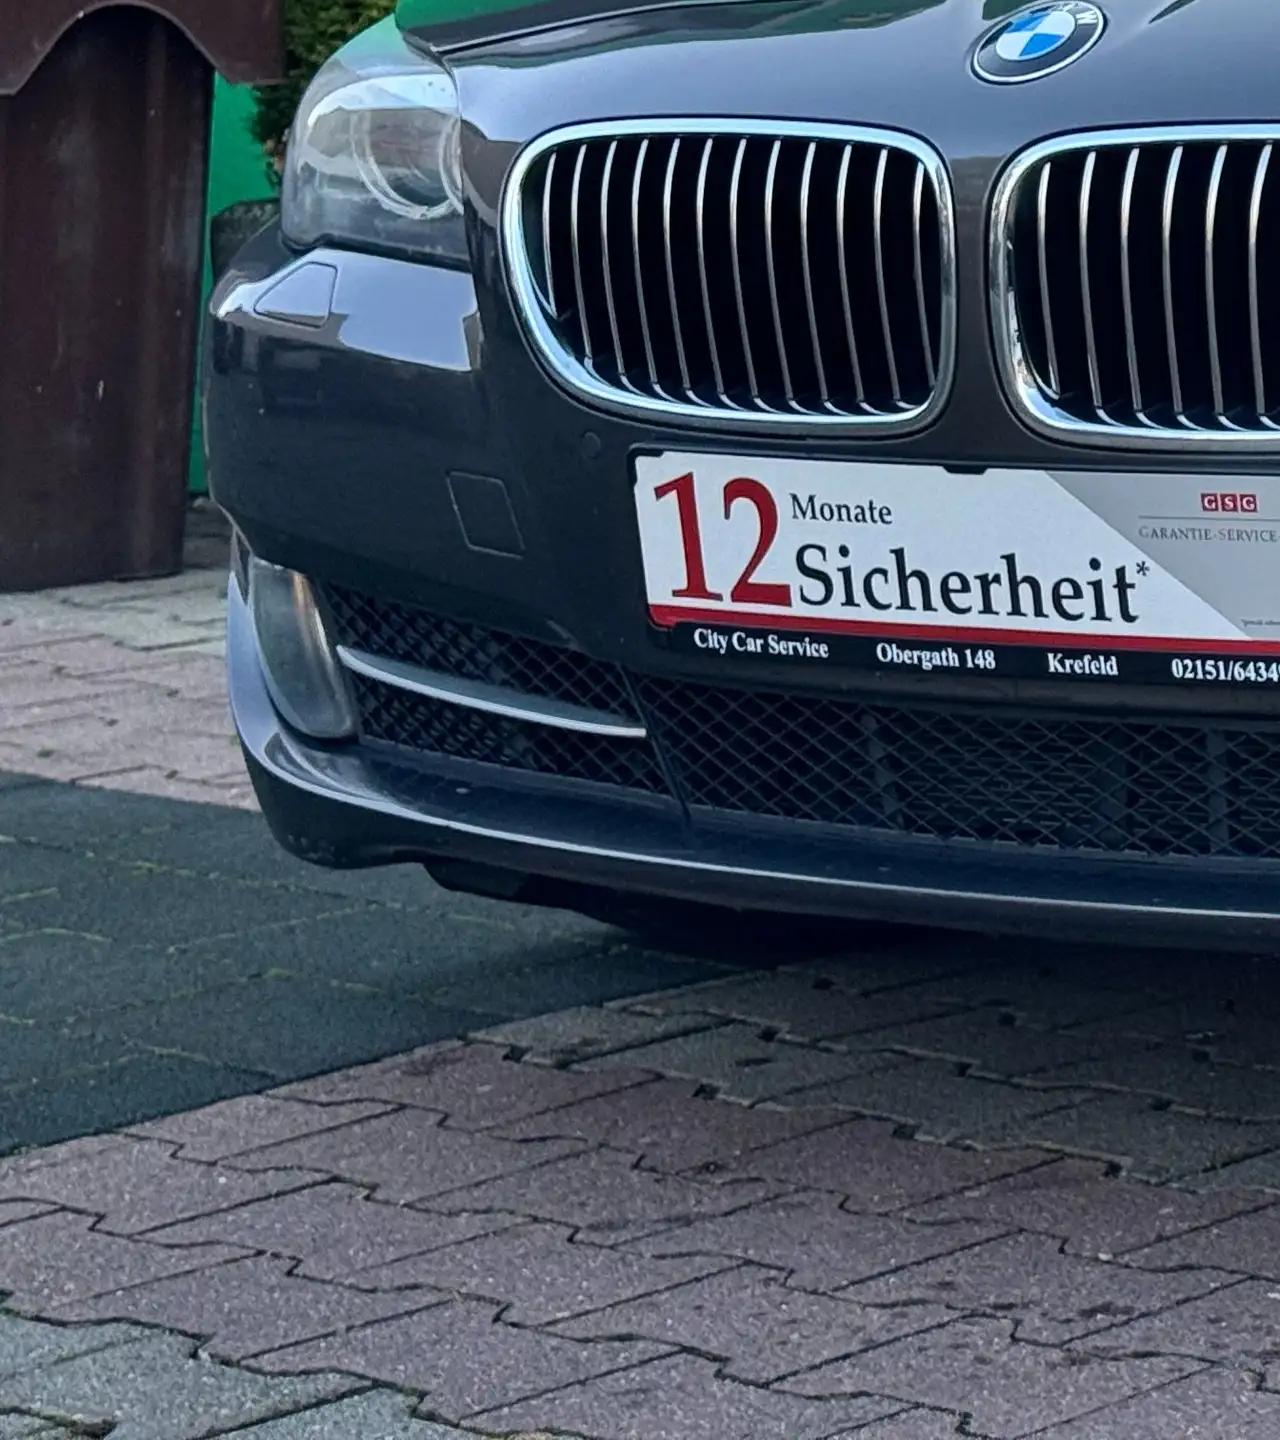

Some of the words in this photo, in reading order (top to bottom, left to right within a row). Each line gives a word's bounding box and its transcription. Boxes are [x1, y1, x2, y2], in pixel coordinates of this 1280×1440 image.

[789, 493, 893, 524] Monate
[1202, 494, 1258, 512] GSG
[654, 471, 792, 608] 12
[693, 627, 729, 654] City
[732, 631, 764, 653] Car
[768, 634, 830, 659] Service
[876, 642, 960, 671] Obergath
[964, 648, 997, 670] 148
[1047, 652, 1119, 676] Krefeld
